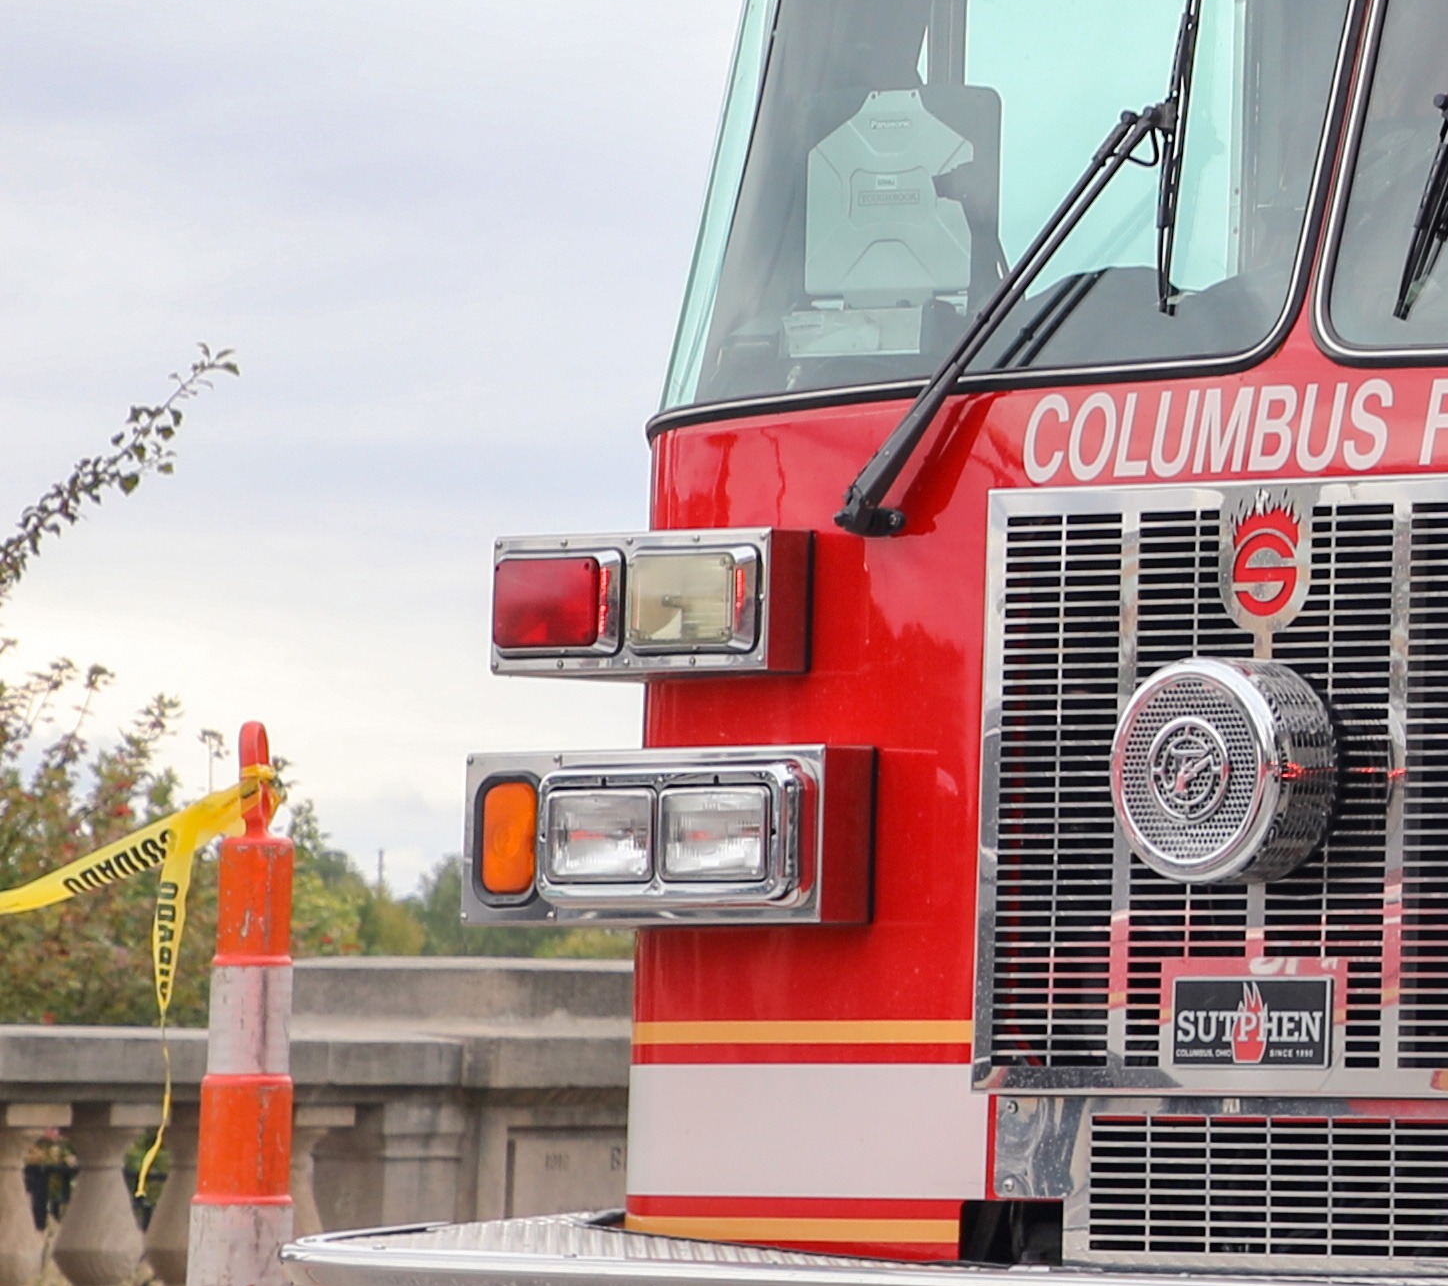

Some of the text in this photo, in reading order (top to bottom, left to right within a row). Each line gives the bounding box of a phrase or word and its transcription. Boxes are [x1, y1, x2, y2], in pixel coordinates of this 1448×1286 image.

[870, 119, 912, 130] Panasonic
[1021, 378, 1393, 484] COLUMBUS
[1176, 1009, 1324, 1044] SUTPHEN
[1269, 1048, 1294, 1058] SINCE
